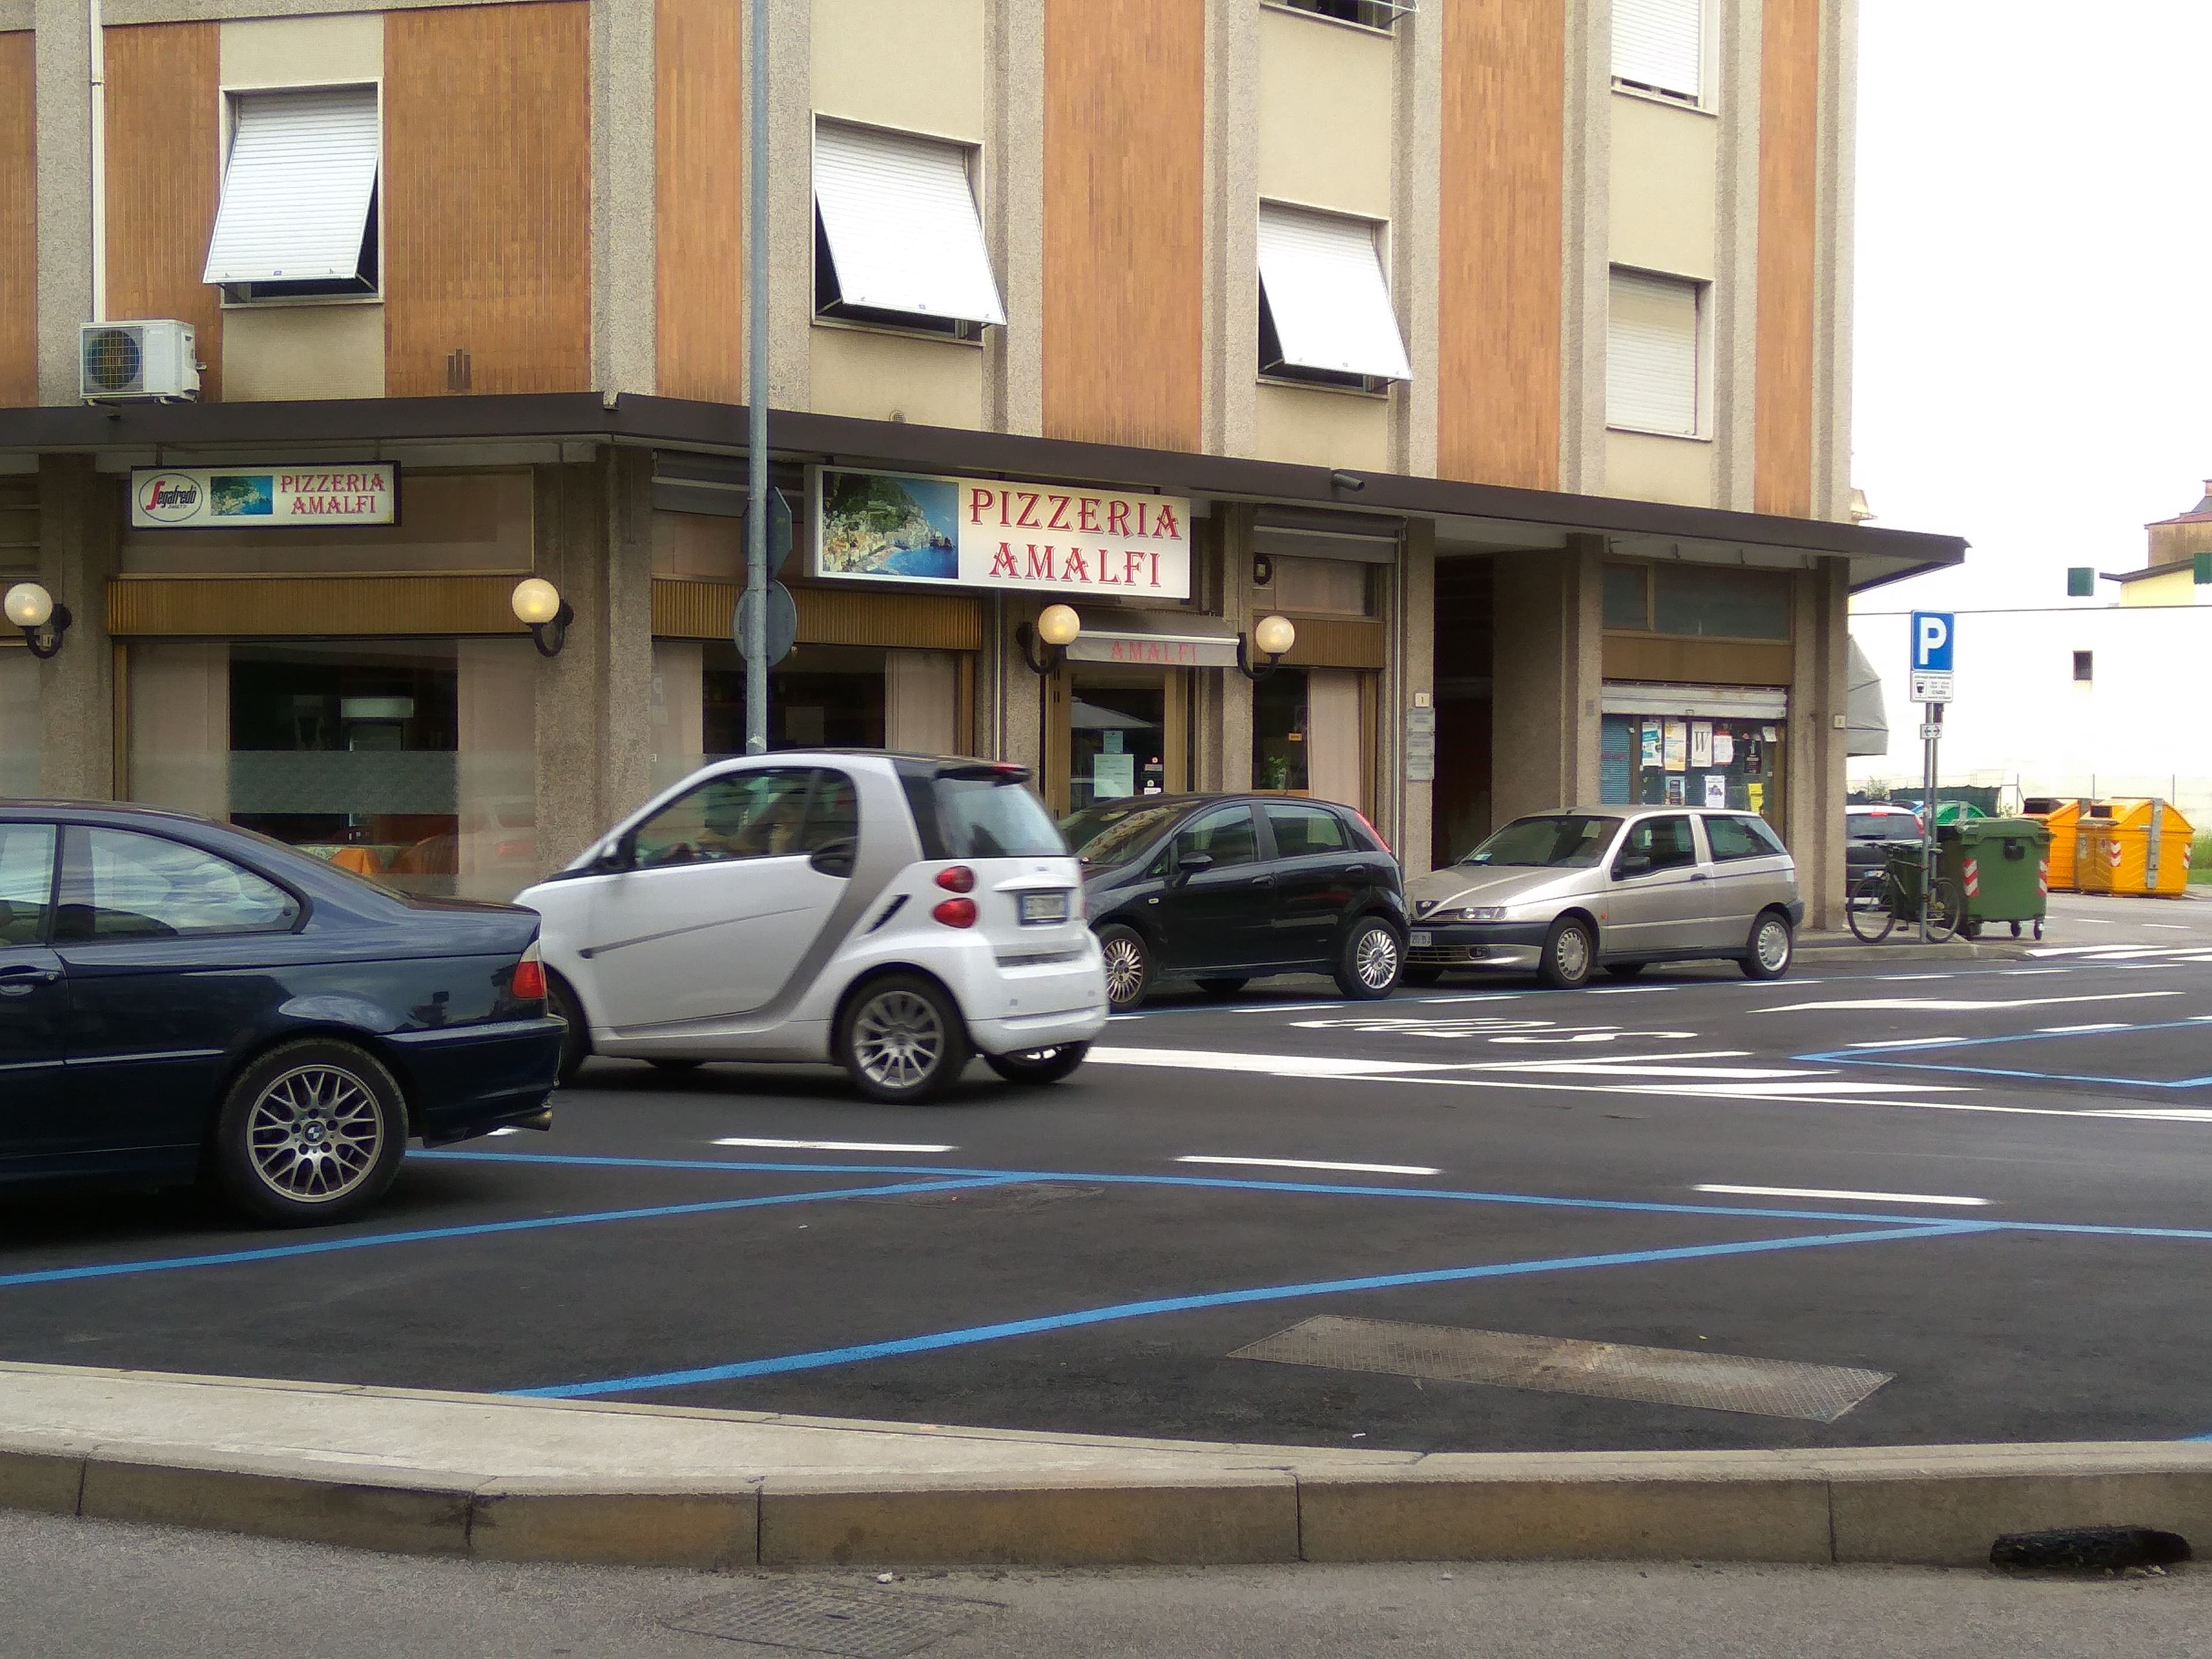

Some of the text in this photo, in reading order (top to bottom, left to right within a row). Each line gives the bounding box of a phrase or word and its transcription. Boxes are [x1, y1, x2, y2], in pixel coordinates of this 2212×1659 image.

[146, 480, 196, 510] Segafredo
[281, 473, 386, 493] PIZZERIA
[291, 495, 376, 514] AMALFI
[968, 488, 1182, 540] PIZZERIA
[988, 541, 1161, 587] AMALFI
[1111, 641, 1197, 664] AMALFI
[1919, 617, 1947, 665] P
[1289, 1018, 1698, 1043] STOP
